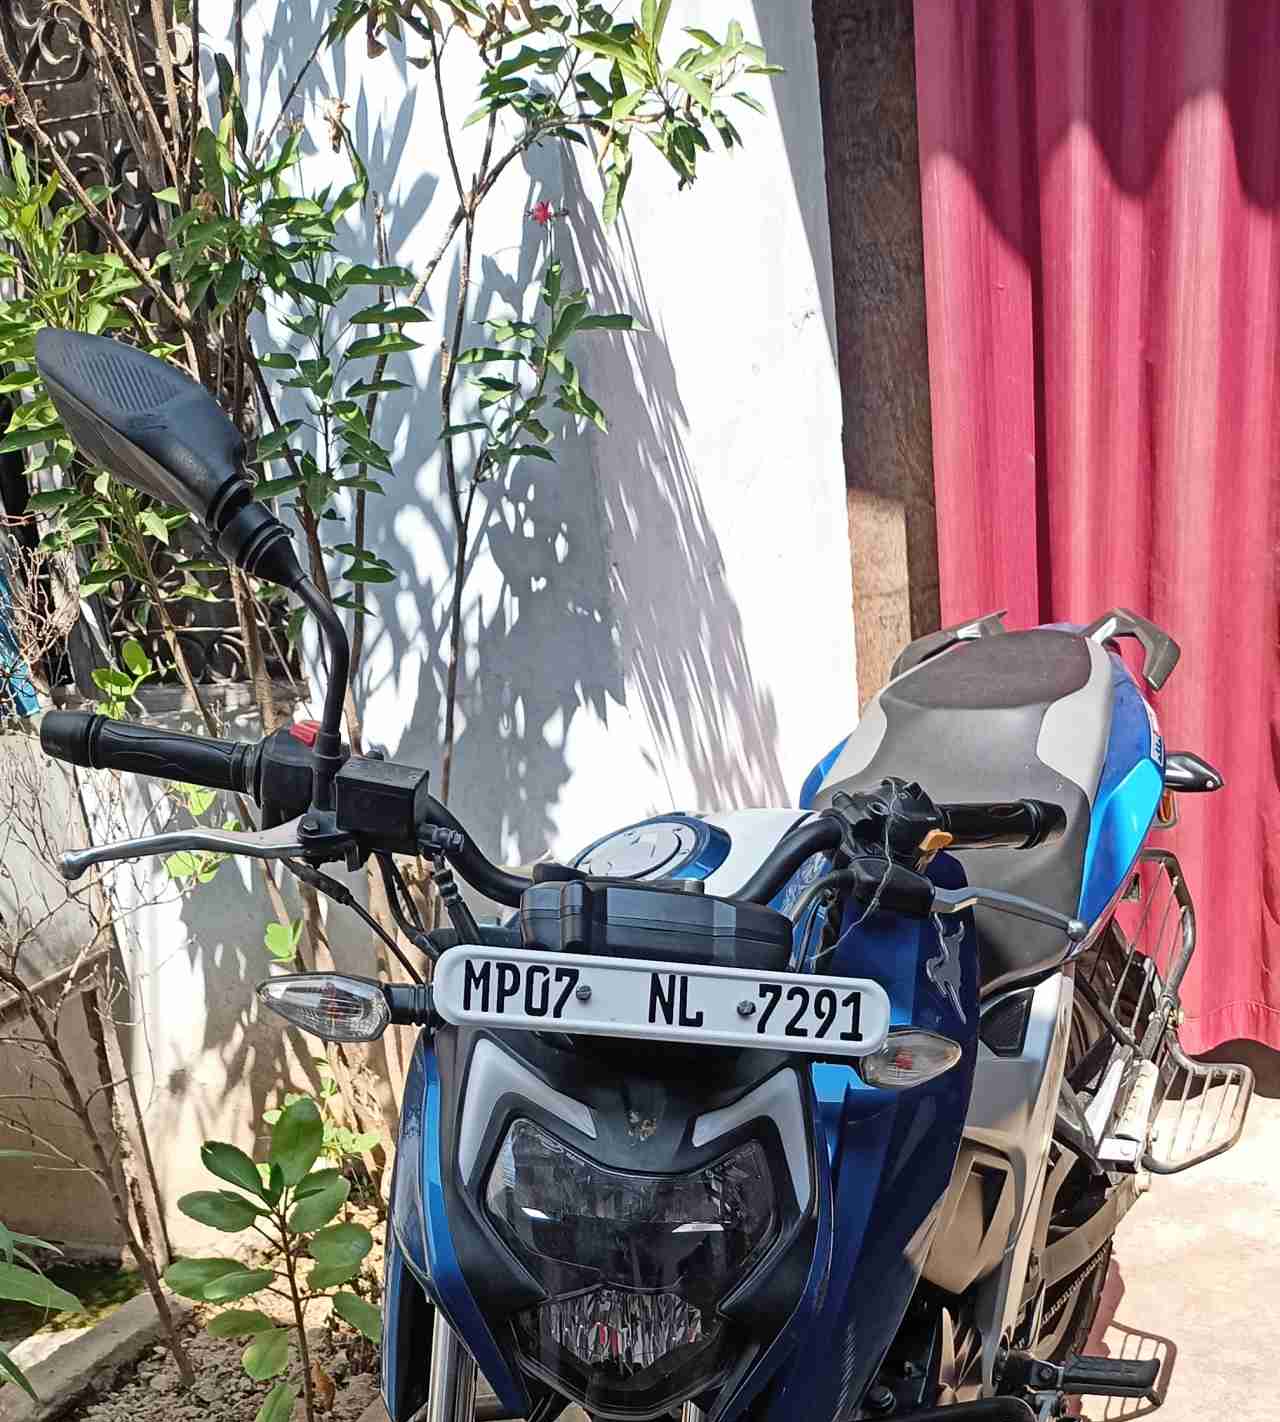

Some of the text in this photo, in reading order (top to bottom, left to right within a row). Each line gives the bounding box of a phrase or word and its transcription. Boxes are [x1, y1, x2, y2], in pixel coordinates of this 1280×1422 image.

[462, 959, 864, 1042] MP07 NL 7291
